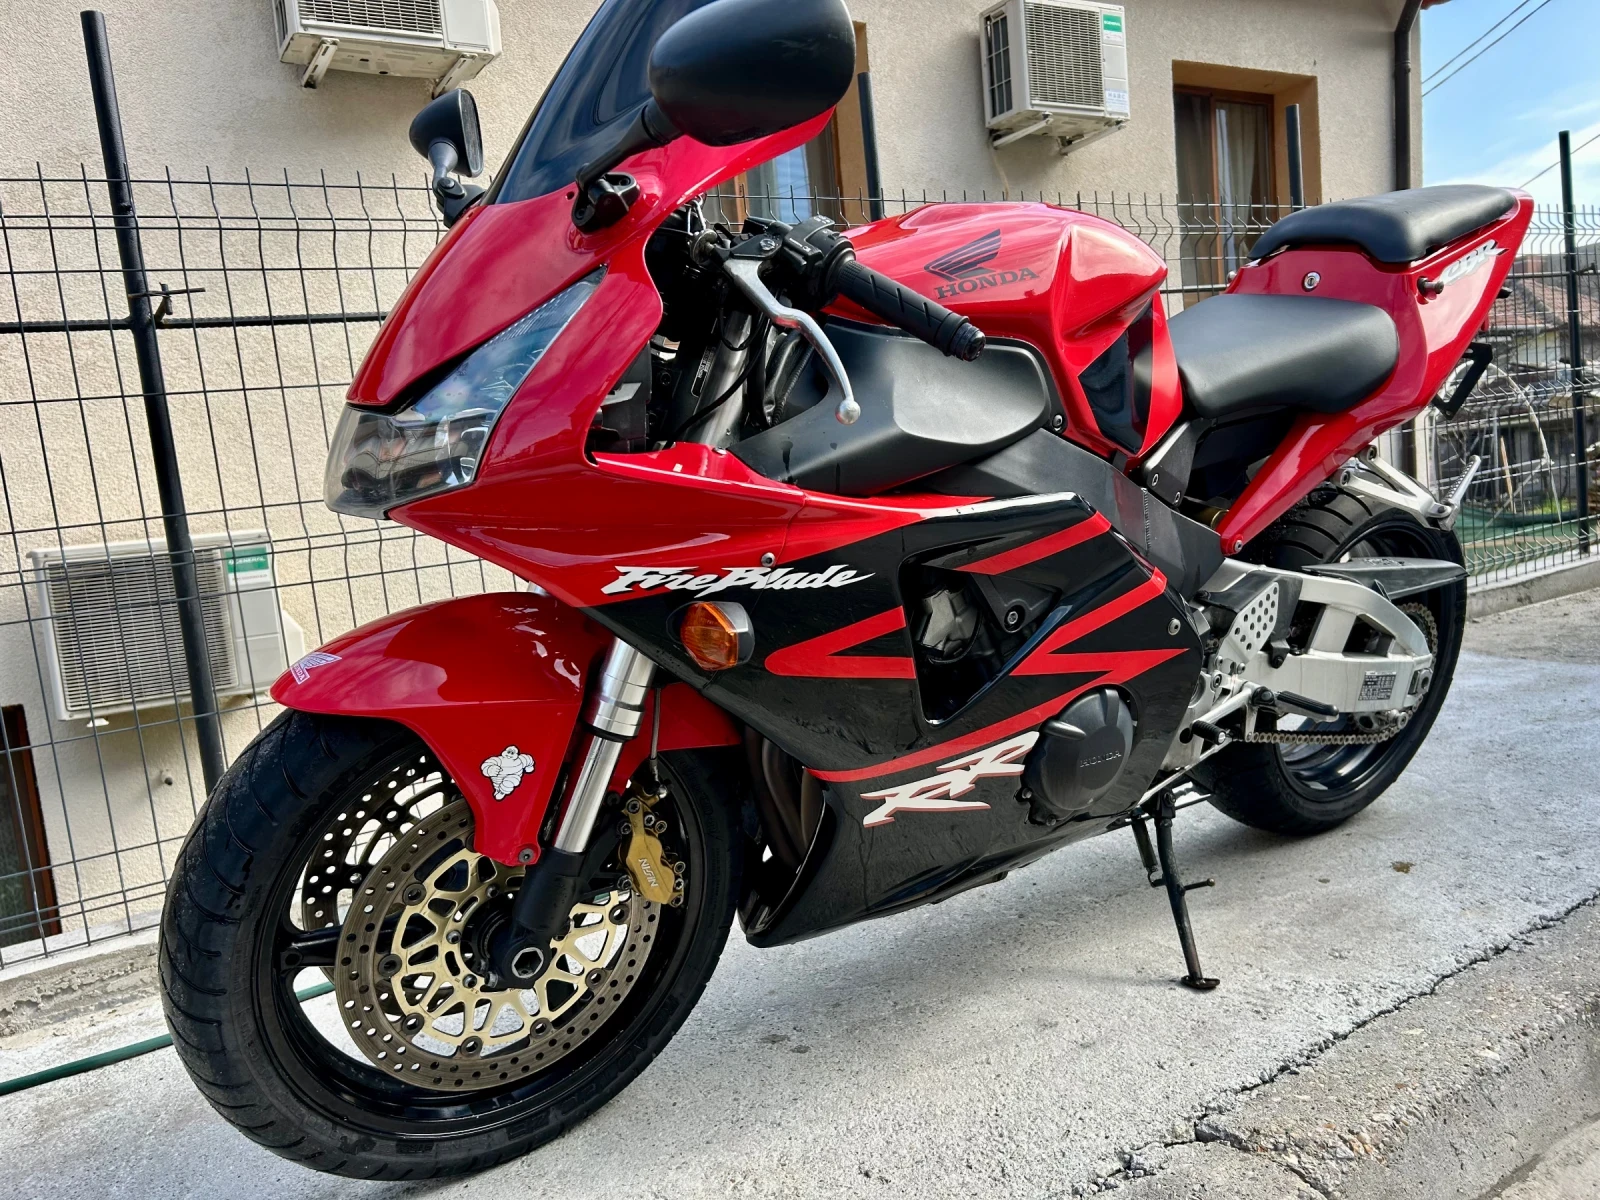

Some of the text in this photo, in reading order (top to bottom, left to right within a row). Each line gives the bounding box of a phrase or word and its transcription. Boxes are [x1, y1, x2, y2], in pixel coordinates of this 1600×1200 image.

[934, 267, 1040, 300] HONDA
[1080, 750, 1122, 768] HONDA
[860, 731, 1040, 828] RR
[638, 858, 659, 887] NISSIN
